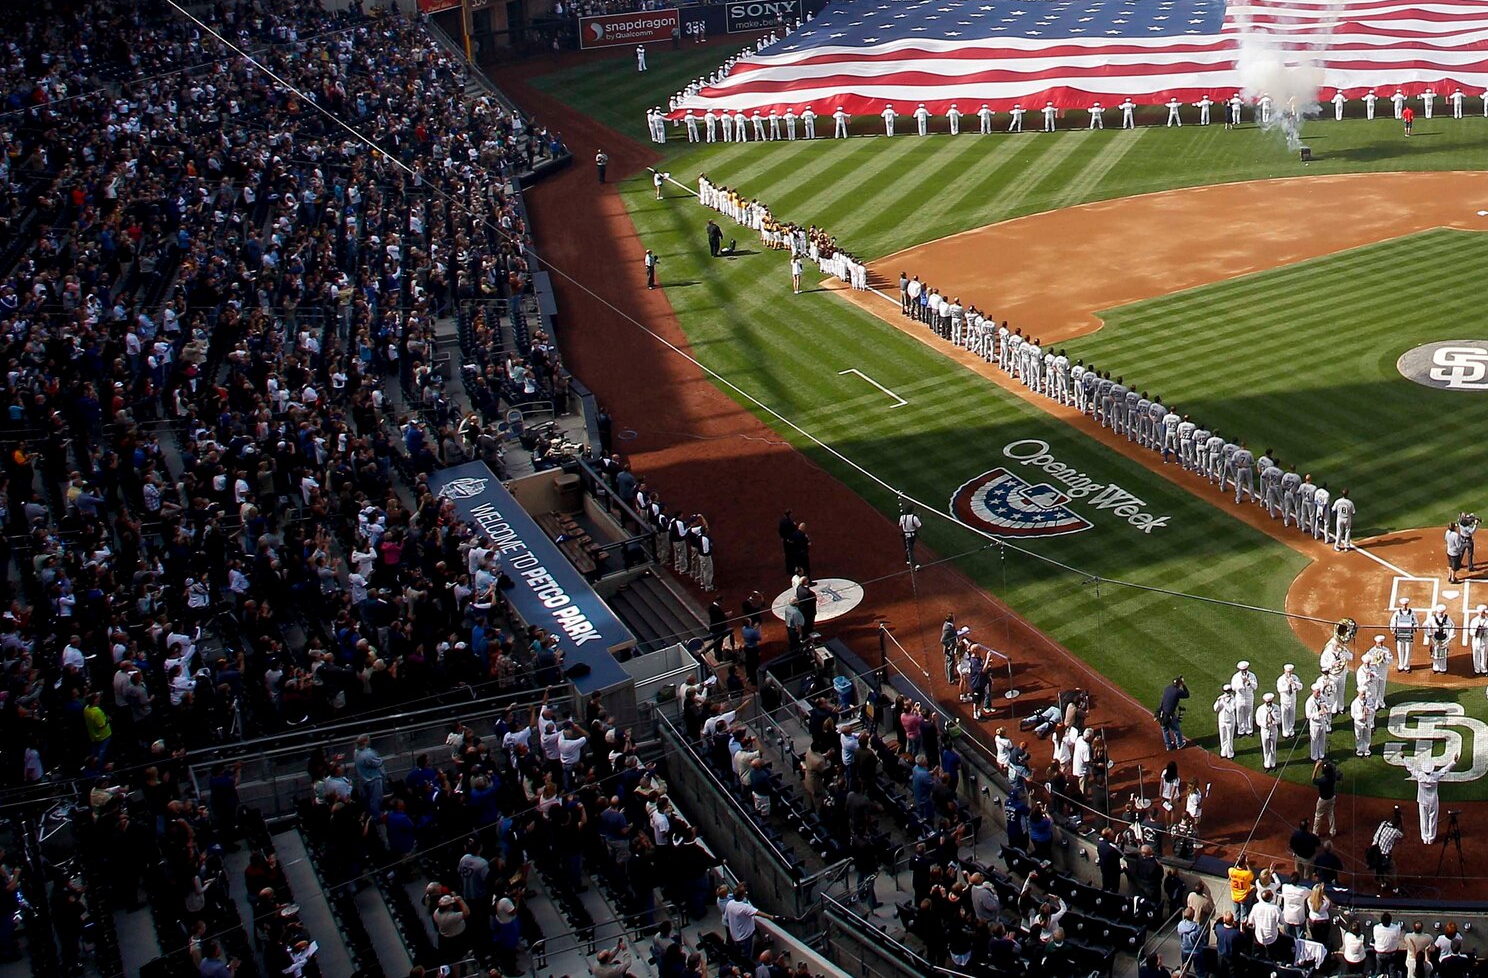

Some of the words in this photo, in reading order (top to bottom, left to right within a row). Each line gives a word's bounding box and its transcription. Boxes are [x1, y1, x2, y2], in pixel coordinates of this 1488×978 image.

[731, 1, 797, 19] SONY
[605, 17, 676, 32] snapdragon
[615, 30, 654, 39] Qualcomm
[1002, 439, 1104, 498] Opening
[1088, 483, 1172, 534] Week
[470, 502, 528, 555] WELCOME
[509, 550, 539, 570] TO
[521, 565, 570, 608] PETCO
[552, 605, 602, 647] PARK
[1233, 881, 1244, 890] 31
